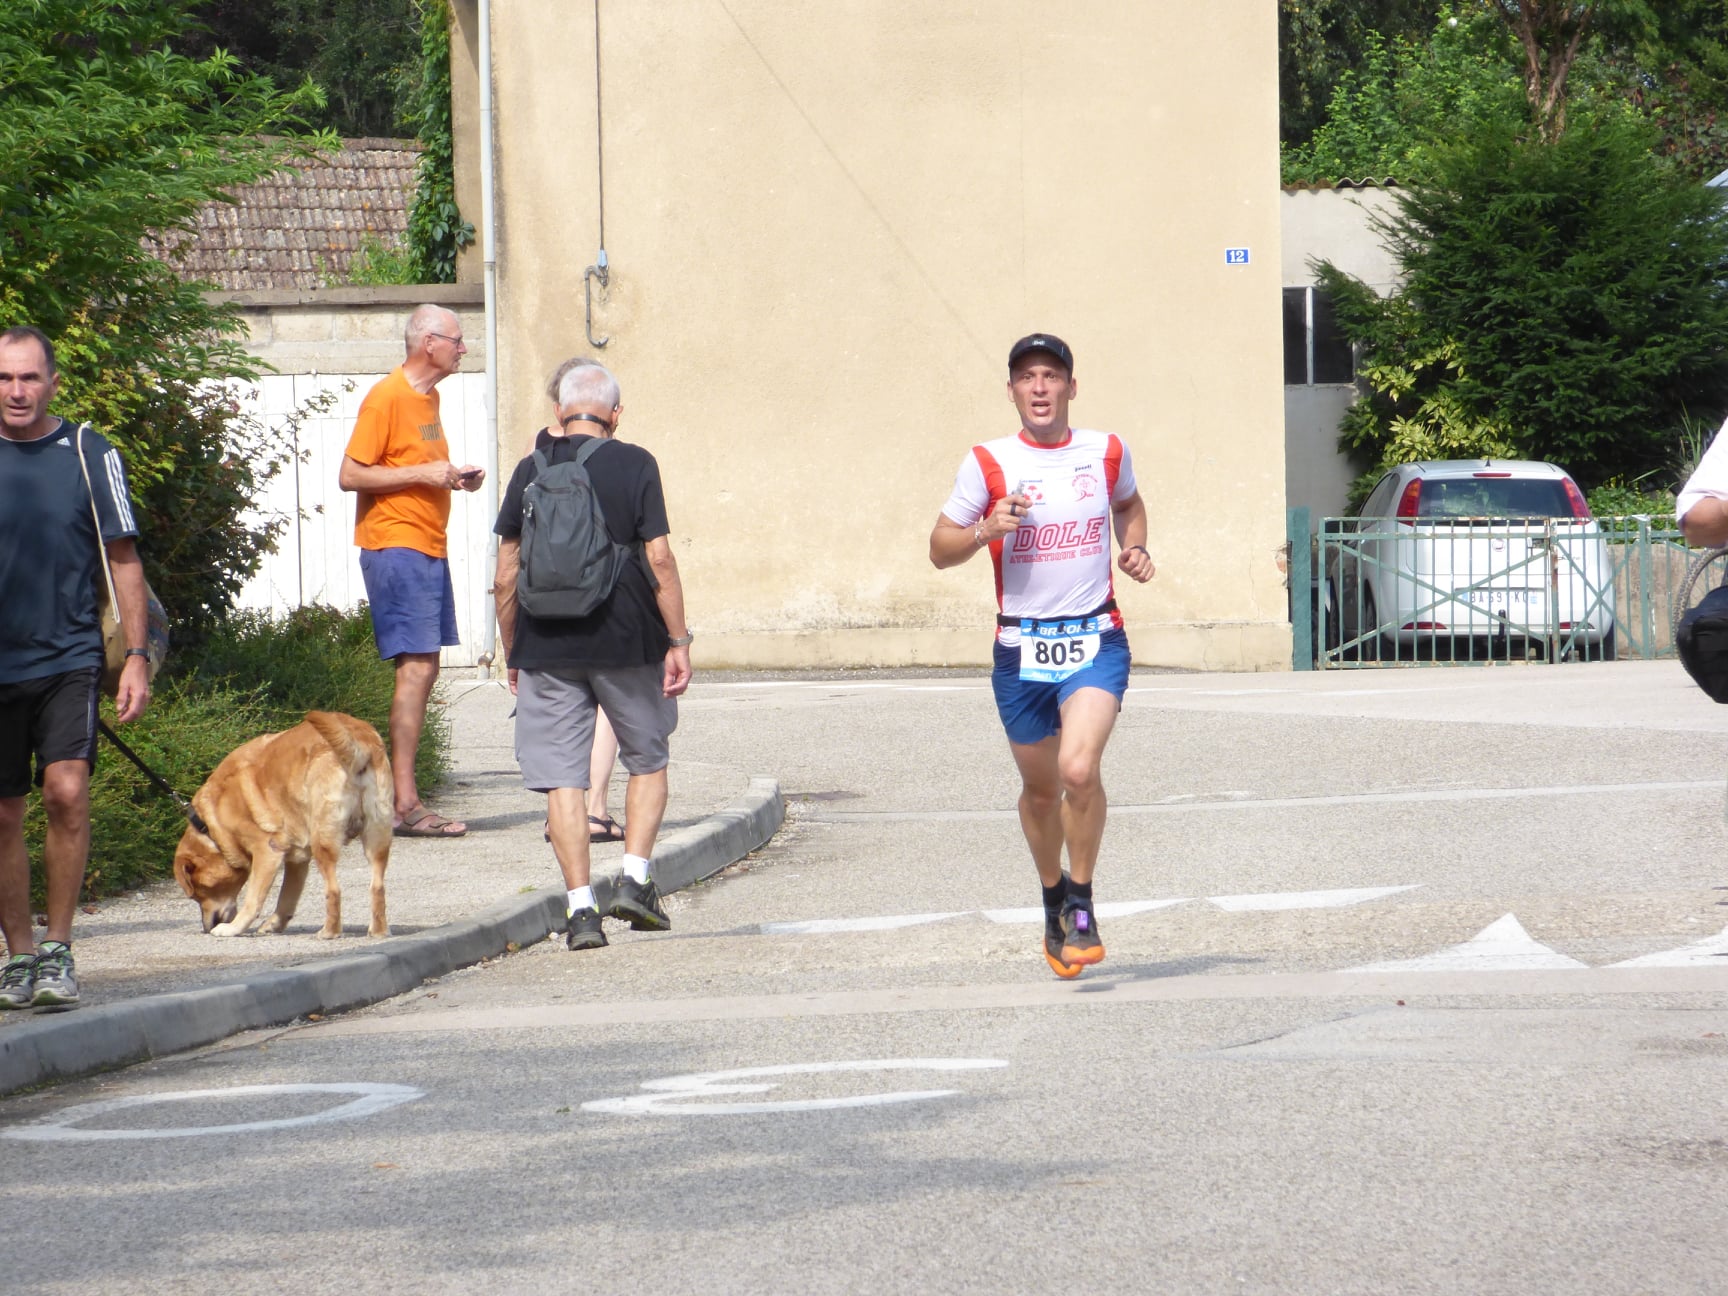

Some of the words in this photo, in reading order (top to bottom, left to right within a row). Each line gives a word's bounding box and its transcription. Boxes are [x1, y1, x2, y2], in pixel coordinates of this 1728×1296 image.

[1230, 250, 1245, 263] 12
[1013, 516, 1106, 552] DOLE
[1035, 640, 1085, 666] 805
